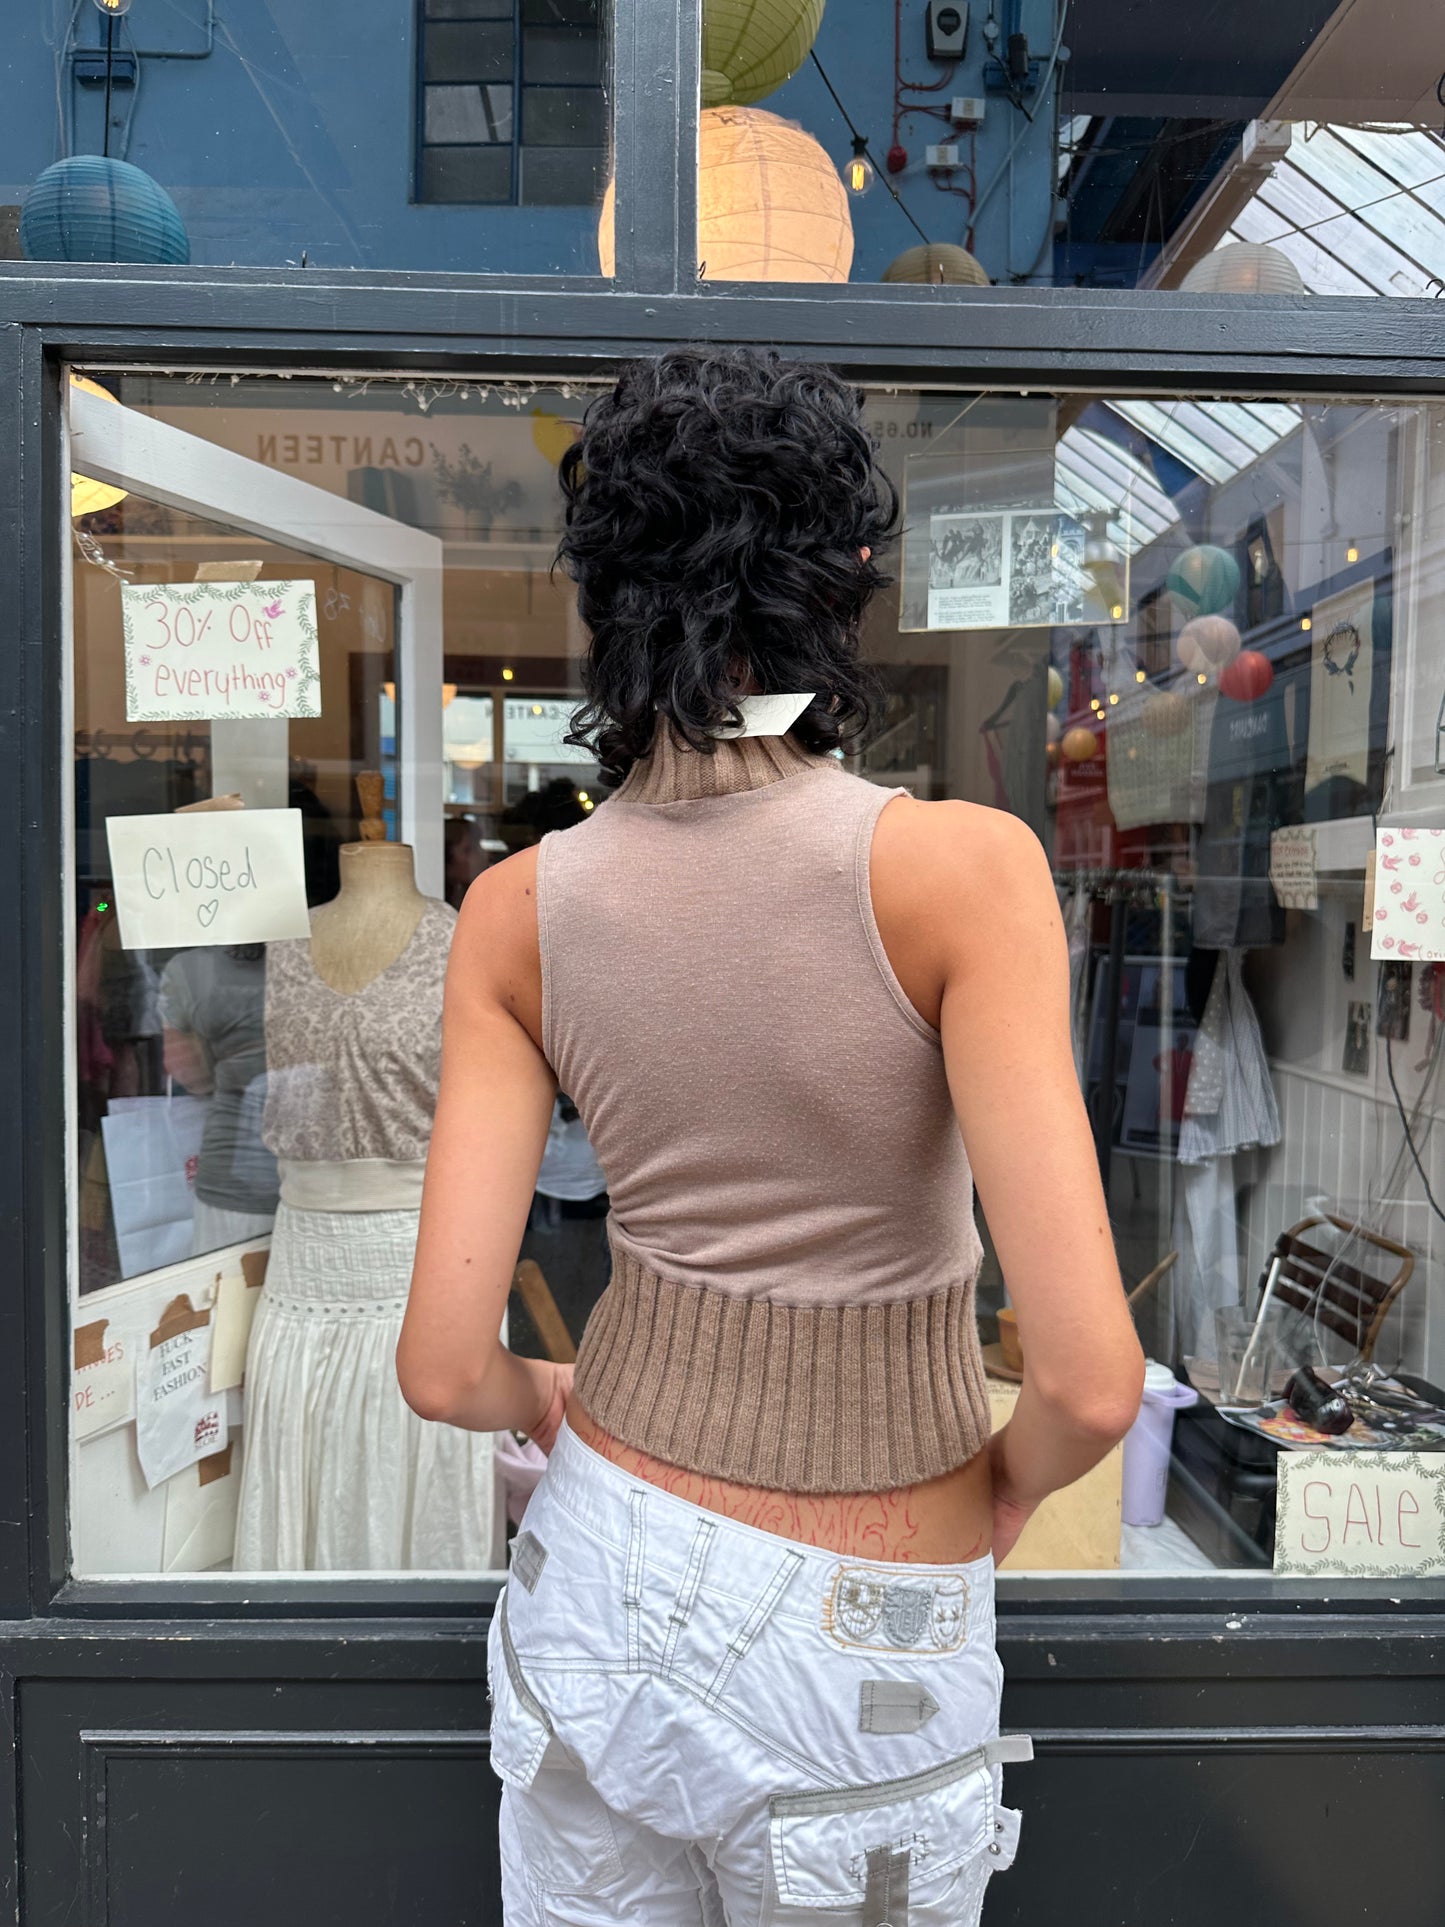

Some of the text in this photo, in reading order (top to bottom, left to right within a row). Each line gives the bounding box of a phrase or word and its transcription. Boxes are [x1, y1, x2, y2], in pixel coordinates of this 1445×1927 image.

[145, 601, 213, 650] 30%
[154, 663, 286, 709] everything
[143, 846, 258, 900] Closed
[152, 1361, 208, 1402] FASHION
[162, 1350, 193, 1376] FAST
